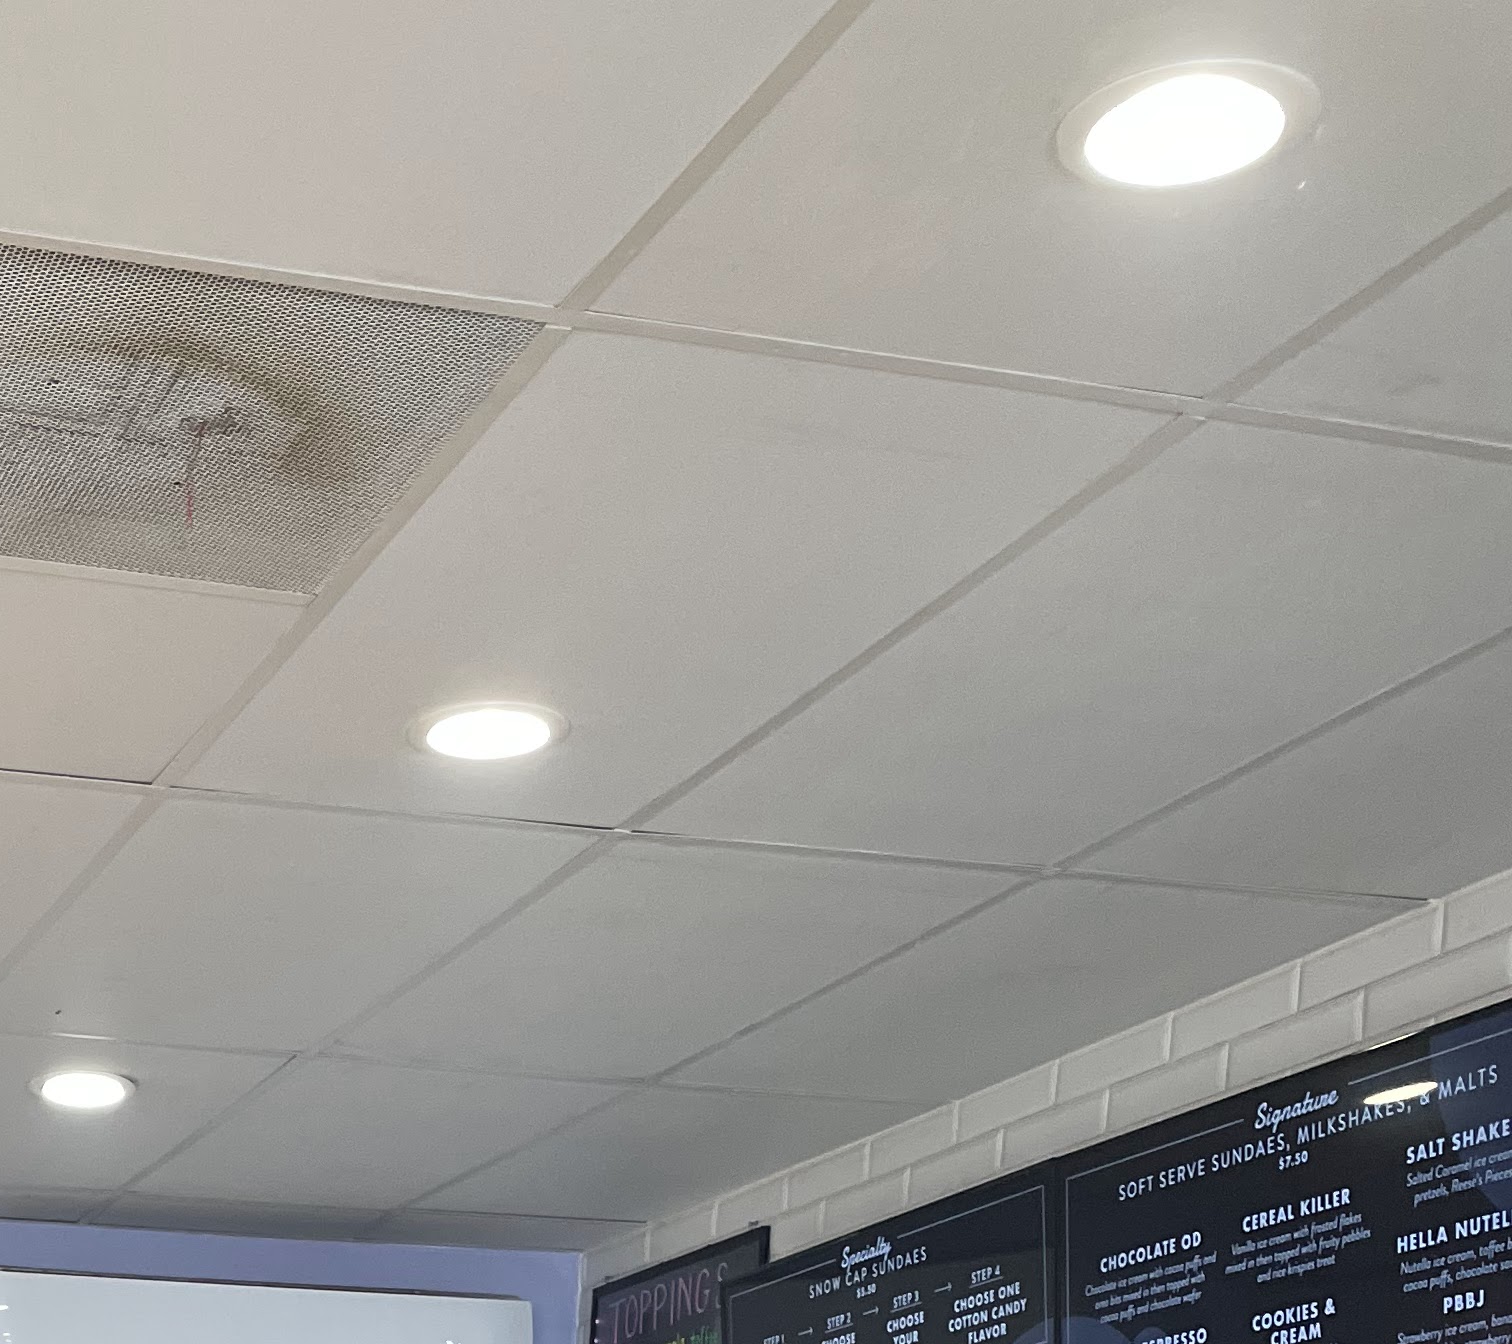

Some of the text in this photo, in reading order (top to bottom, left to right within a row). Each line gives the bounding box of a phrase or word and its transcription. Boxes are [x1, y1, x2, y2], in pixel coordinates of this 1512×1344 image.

[1254, 1089, 1339, 1135] Signature
[1118, 1172, 1155, 1202] SOFT
[1158, 1157, 1206, 1190] SERVE
[1211, 1132, 1291, 1172] SUNDAES,
[1297, 1099, 1413, 1145] MILKSHAKES,
[1438, 1063, 1499, 1102] MALTS
[1277, 1150, 1309, 1171] $7.50
[1406, 1137, 1445, 1164] SALT
[1242, 1188, 1351, 1233] CEREAL KILLER
[1397, 1209, 1512, 1254] HELLA NUTEL
[841, 1235, 892, 1273] Specialty
[1100, 1231, 1202, 1274] CHOCOLATE OD
[809, 1246, 928, 1300] SNOW CAP SUNDAES
[970, 1265, 1001, 1284] STEP 4
[892, 1290, 921, 1309] STEP 3
[953, 1281, 1021, 1313] CHOOSE ONE
[1442, 1288, 1485, 1314] PBBJ
[826, 1314, 844, 1330] STEP
[886, 1311, 925, 1333] CHOOSE
[947, 1298, 1028, 1333] COTTON CANDY
[1251, 1298, 1336, 1332] COOKIES &
[967, 1322, 1008, 1344] FLAVOR
